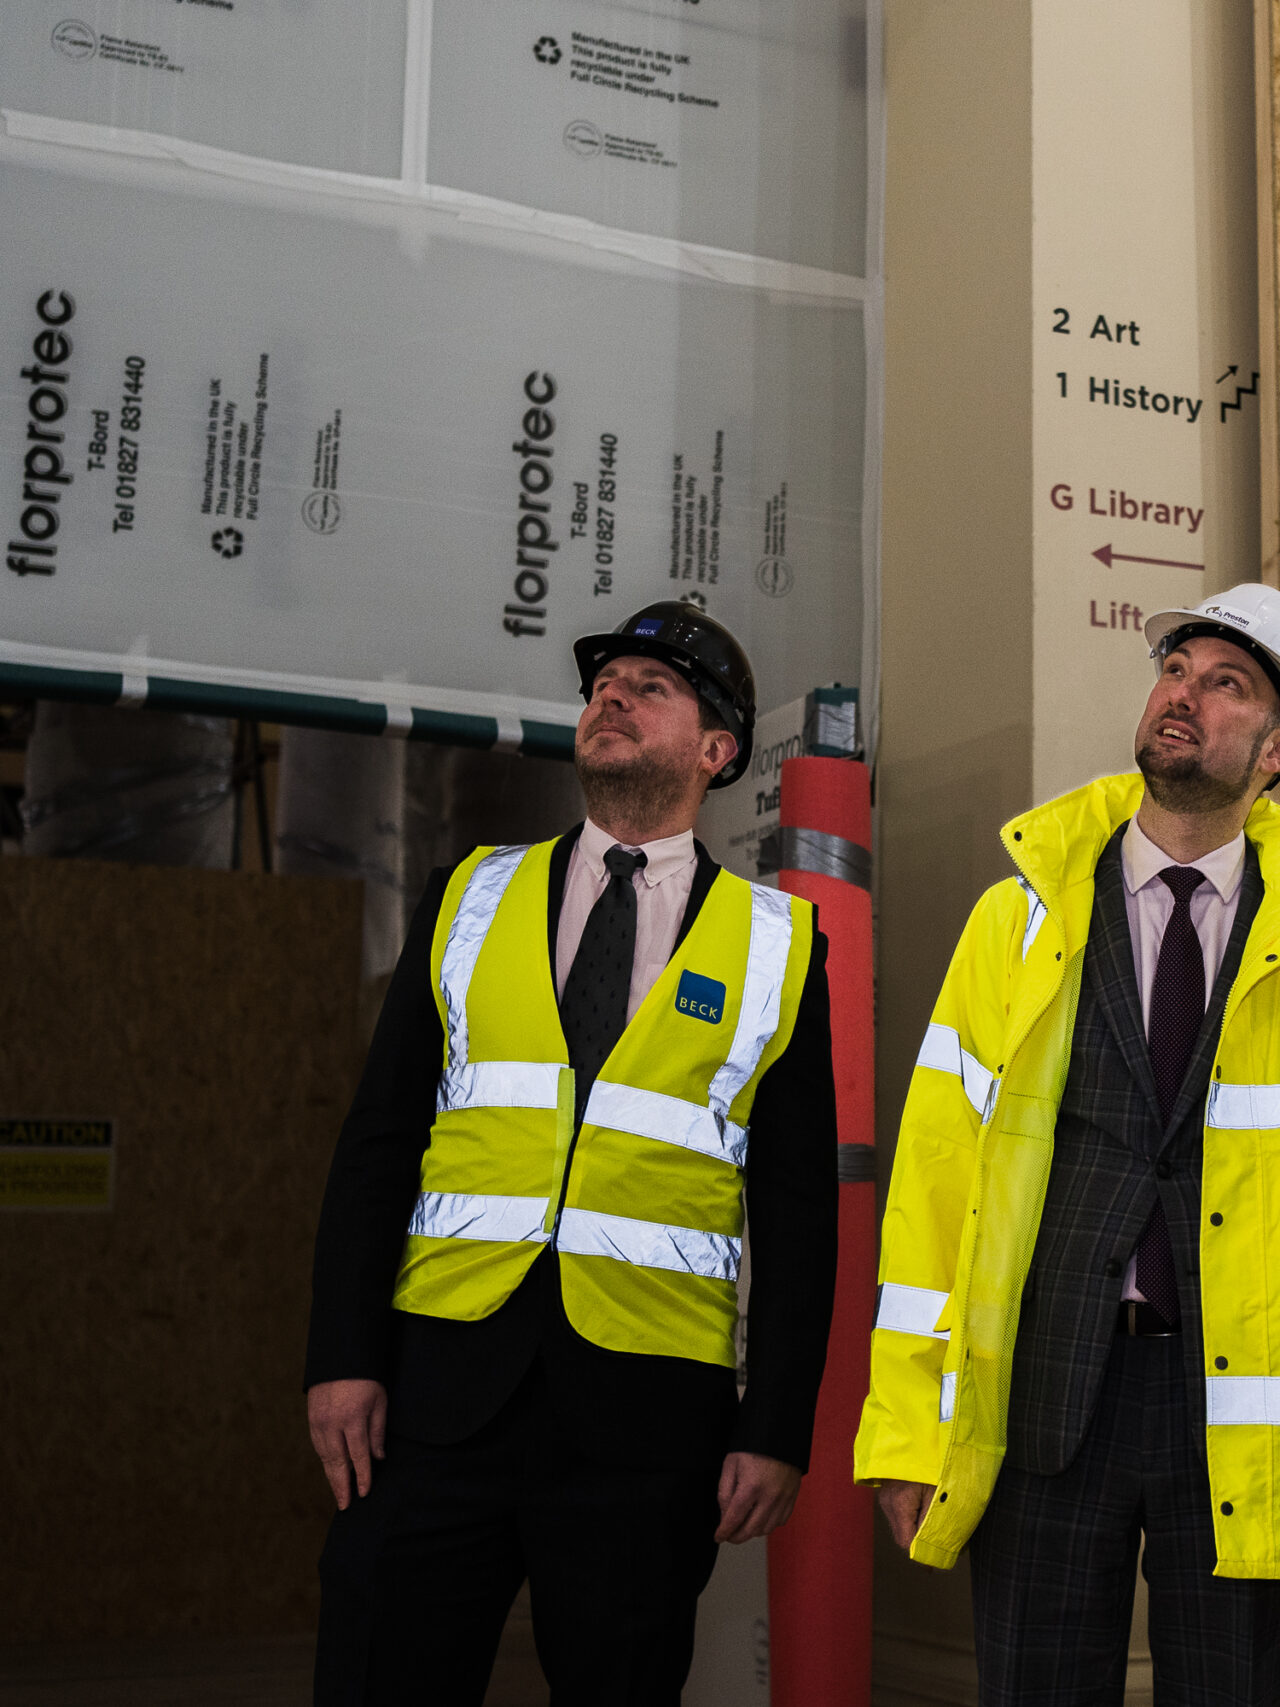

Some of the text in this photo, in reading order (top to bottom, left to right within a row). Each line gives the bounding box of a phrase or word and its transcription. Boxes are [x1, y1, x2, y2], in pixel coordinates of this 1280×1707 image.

[571, 59, 655, 83] recyclable under
[572, 31, 691, 65] Manufactured in the UK
[572, 44, 672, 76] This product is fully
[571, 70, 719, 108] Full Circle Recycling Scheme
[1052, 307, 1140, 346] 2 Art
[1056, 371, 1203, 423] 1 History
[6, 288, 76, 577] florprotec
[87, 410, 109, 471] T-Bord
[112, 355, 146, 533] Tel 01827 831440
[201, 379, 221, 514] Manufactured in the UK
[216, 400, 238, 516] This product is fully
[246, 353, 269, 520] Full Circle Recycling Scheme
[234, 422, 249, 518] recyclable under
[685, 474, 698, 499] fully
[502, 370, 558, 638] florprotec
[571, 481, 589, 539] T-Bord
[594, 433, 618, 597] Tel 01827 831440
[670, 454, 684, 579] Manufactured in the UK
[708, 429, 724, 584] Full Circle Recycling Scheme
[1050, 483, 1204, 534] G Library
[682, 557, 693, 580] This
[1089, 600, 1143, 633] Lift
[1223, 612, 1250, 626] Preston
[679, 996, 718, 1020] BECK
